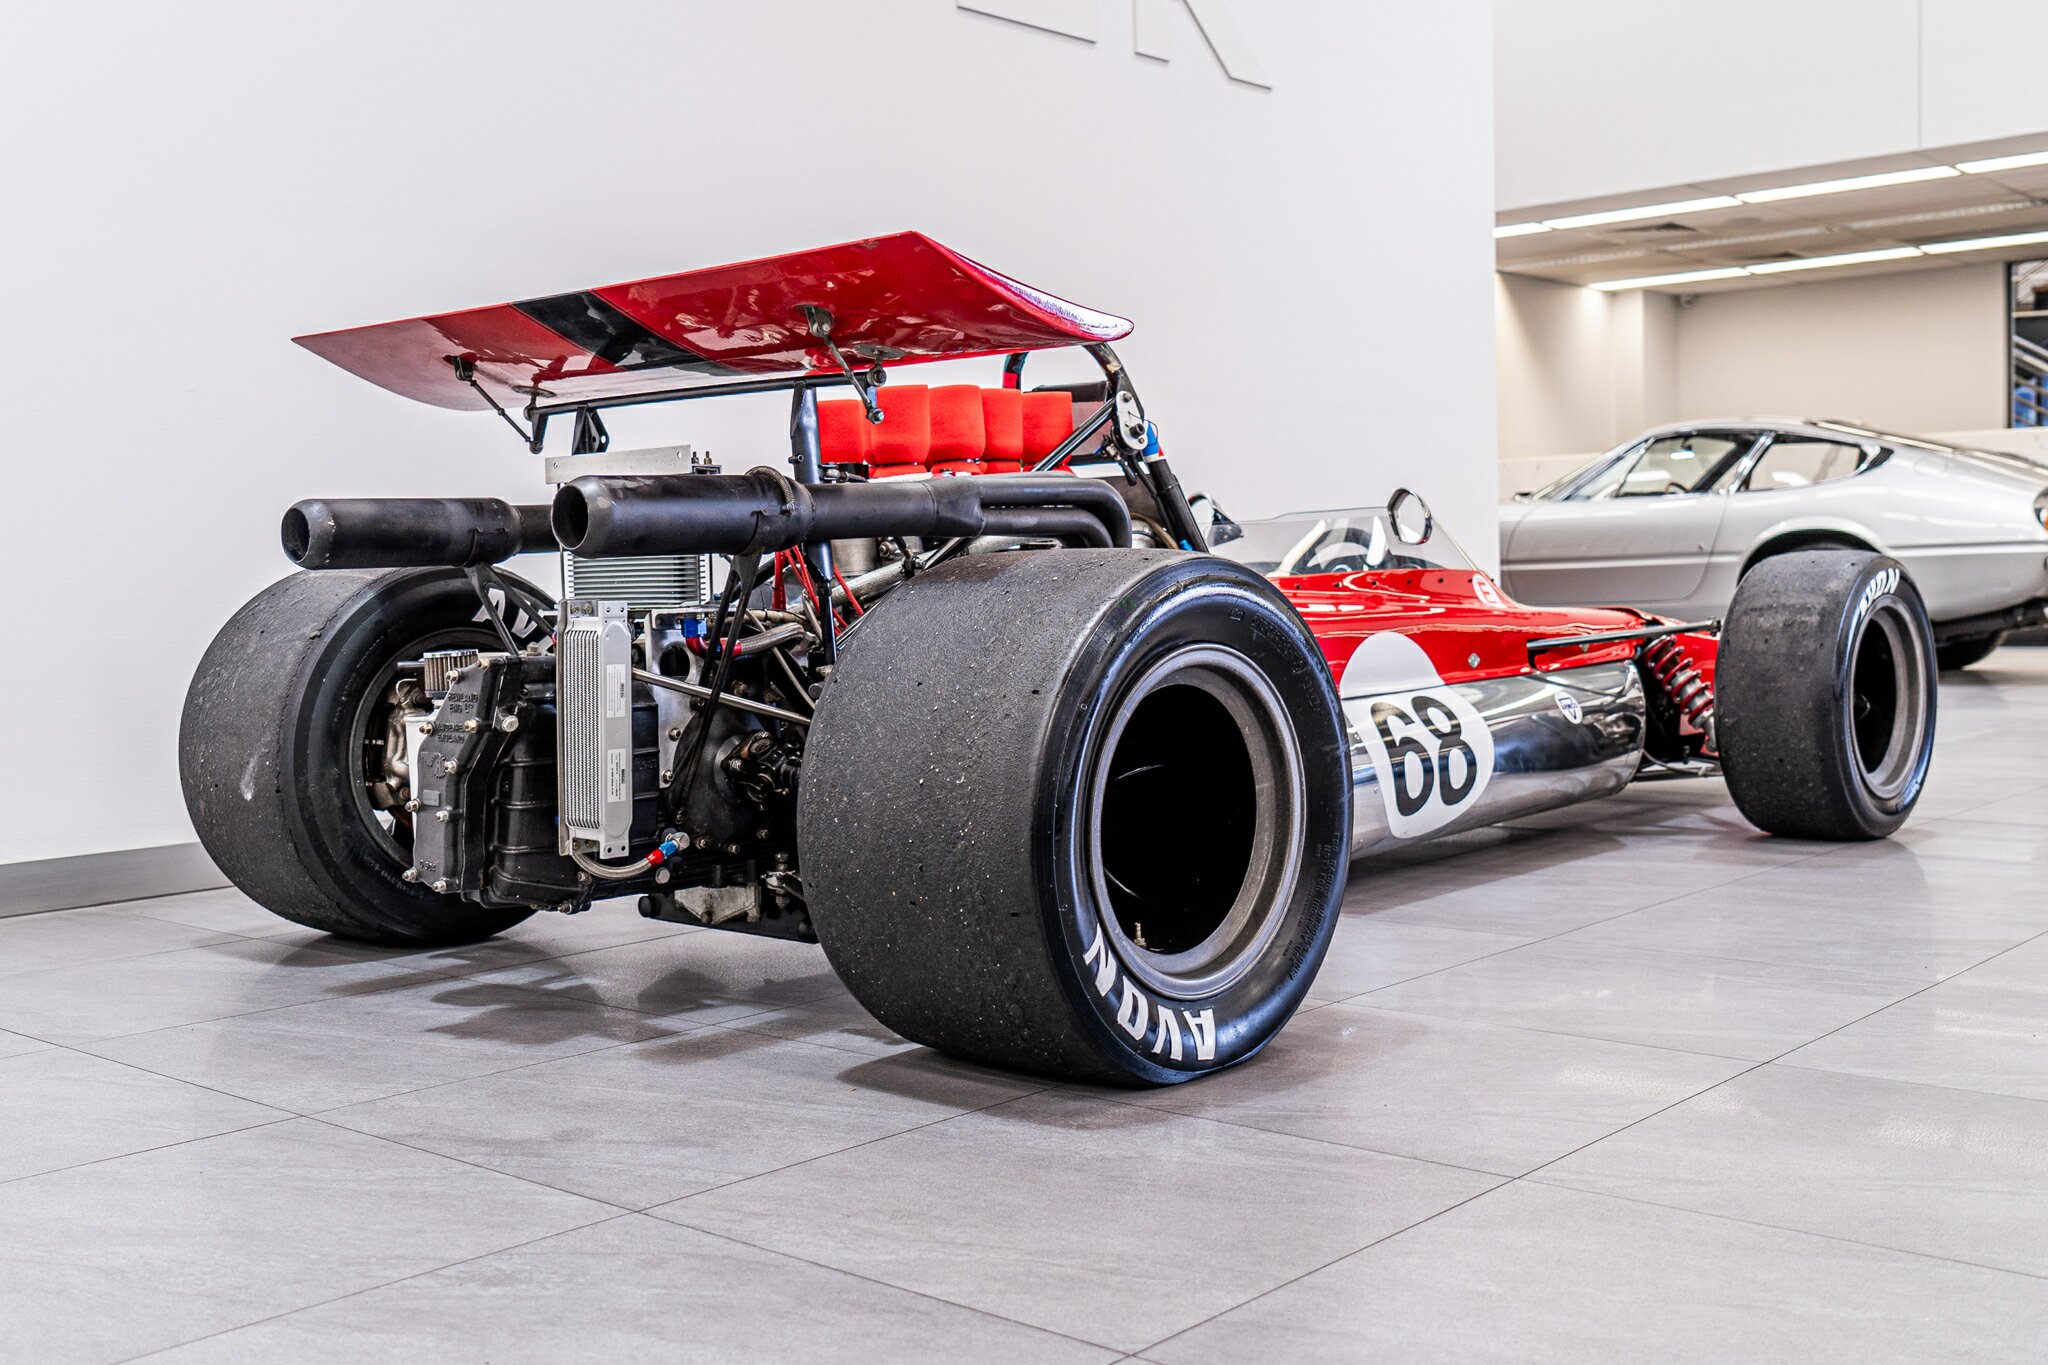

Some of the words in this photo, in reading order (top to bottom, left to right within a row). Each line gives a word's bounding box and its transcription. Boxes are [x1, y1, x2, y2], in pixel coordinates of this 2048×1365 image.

[1860, 568, 1899, 619] AVON
[1371, 695, 1477, 817] 68
[1083, 923, 1216, 1061] AVON
